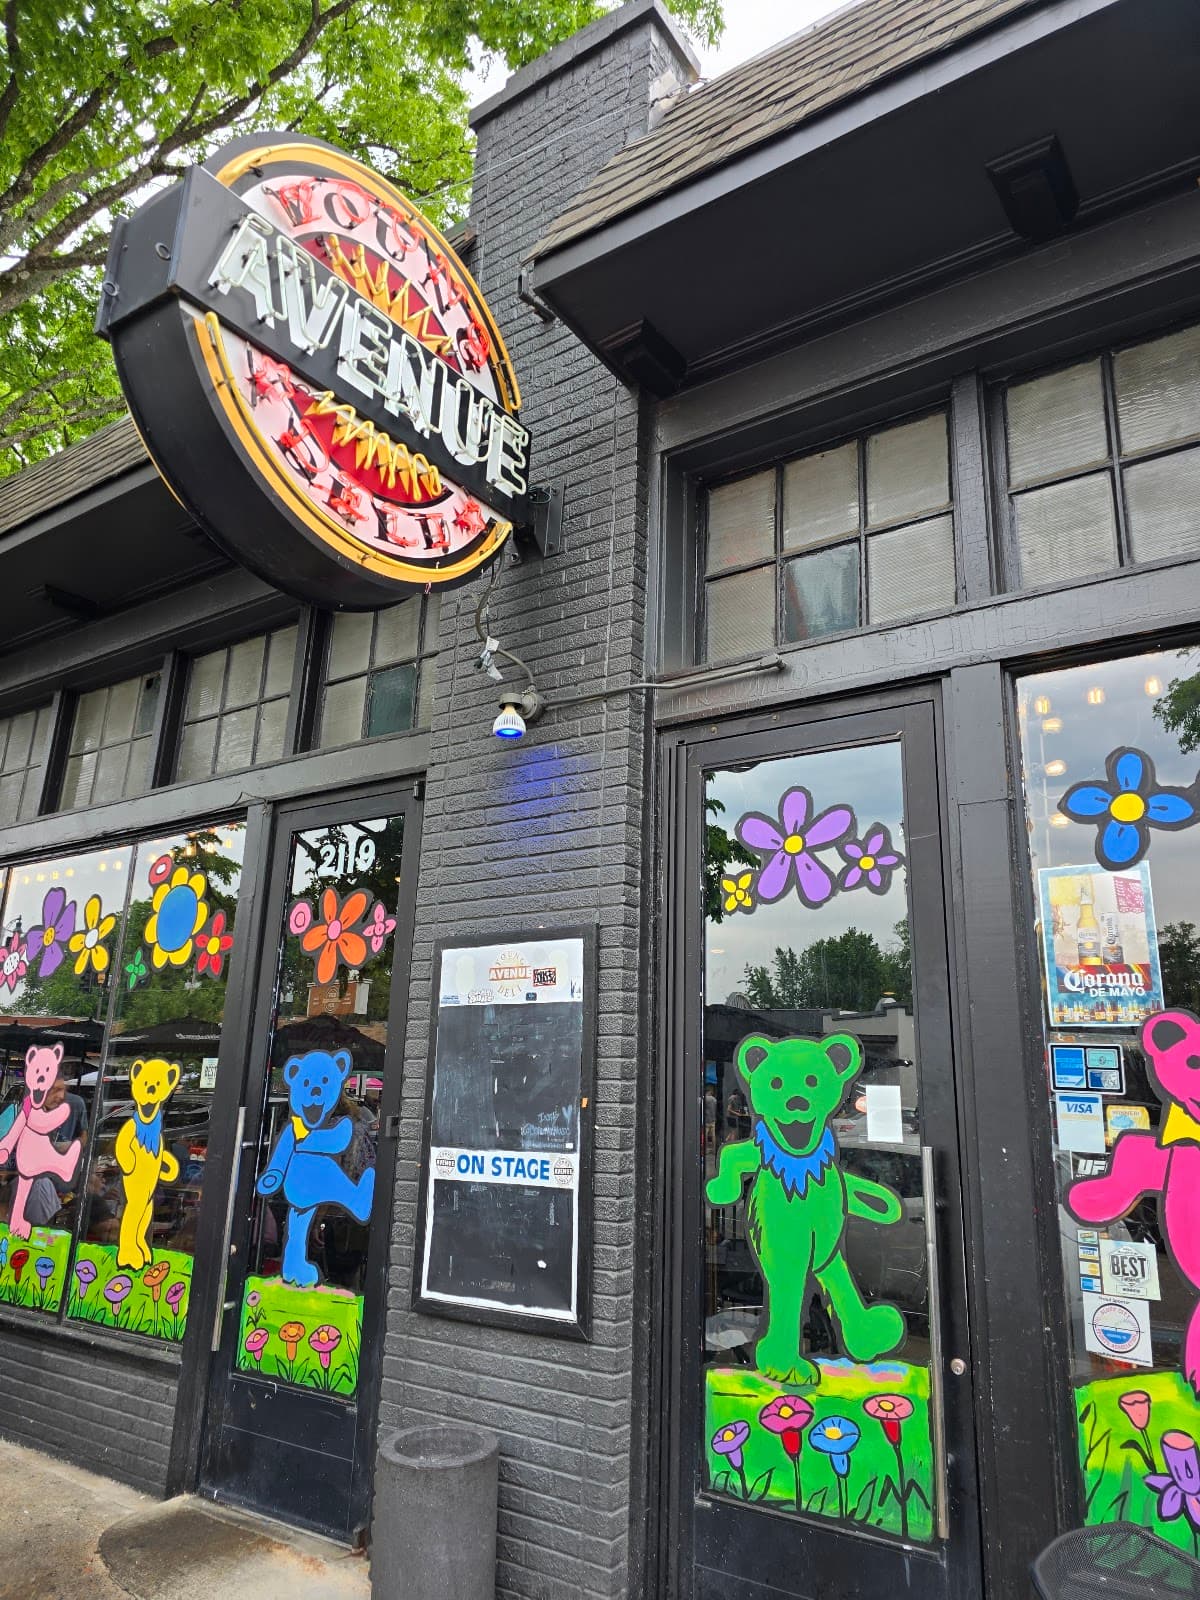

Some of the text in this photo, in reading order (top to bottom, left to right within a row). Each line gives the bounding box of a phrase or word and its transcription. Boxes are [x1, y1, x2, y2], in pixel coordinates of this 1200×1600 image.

[263, 177, 491, 374] YOUNG
[208, 212, 529, 499] AVENUE
[271, 410, 452, 554] DELI
[317, 838, 376, 879] 2119
[489, 967, 532, 980] AVENUE
[1063, 968, 1145, 993] Corona
[1089, 985, 1146, 998] DE MAYO
[1066, 1102, 1093, 1114] VISA
[456, 1154, 485, 1175] ON
[491, 1156, 550, 1181] STAGE
[1077, 1159, 1108, 1176] UF
[1110, 1254, 1147, 1279] BEST
